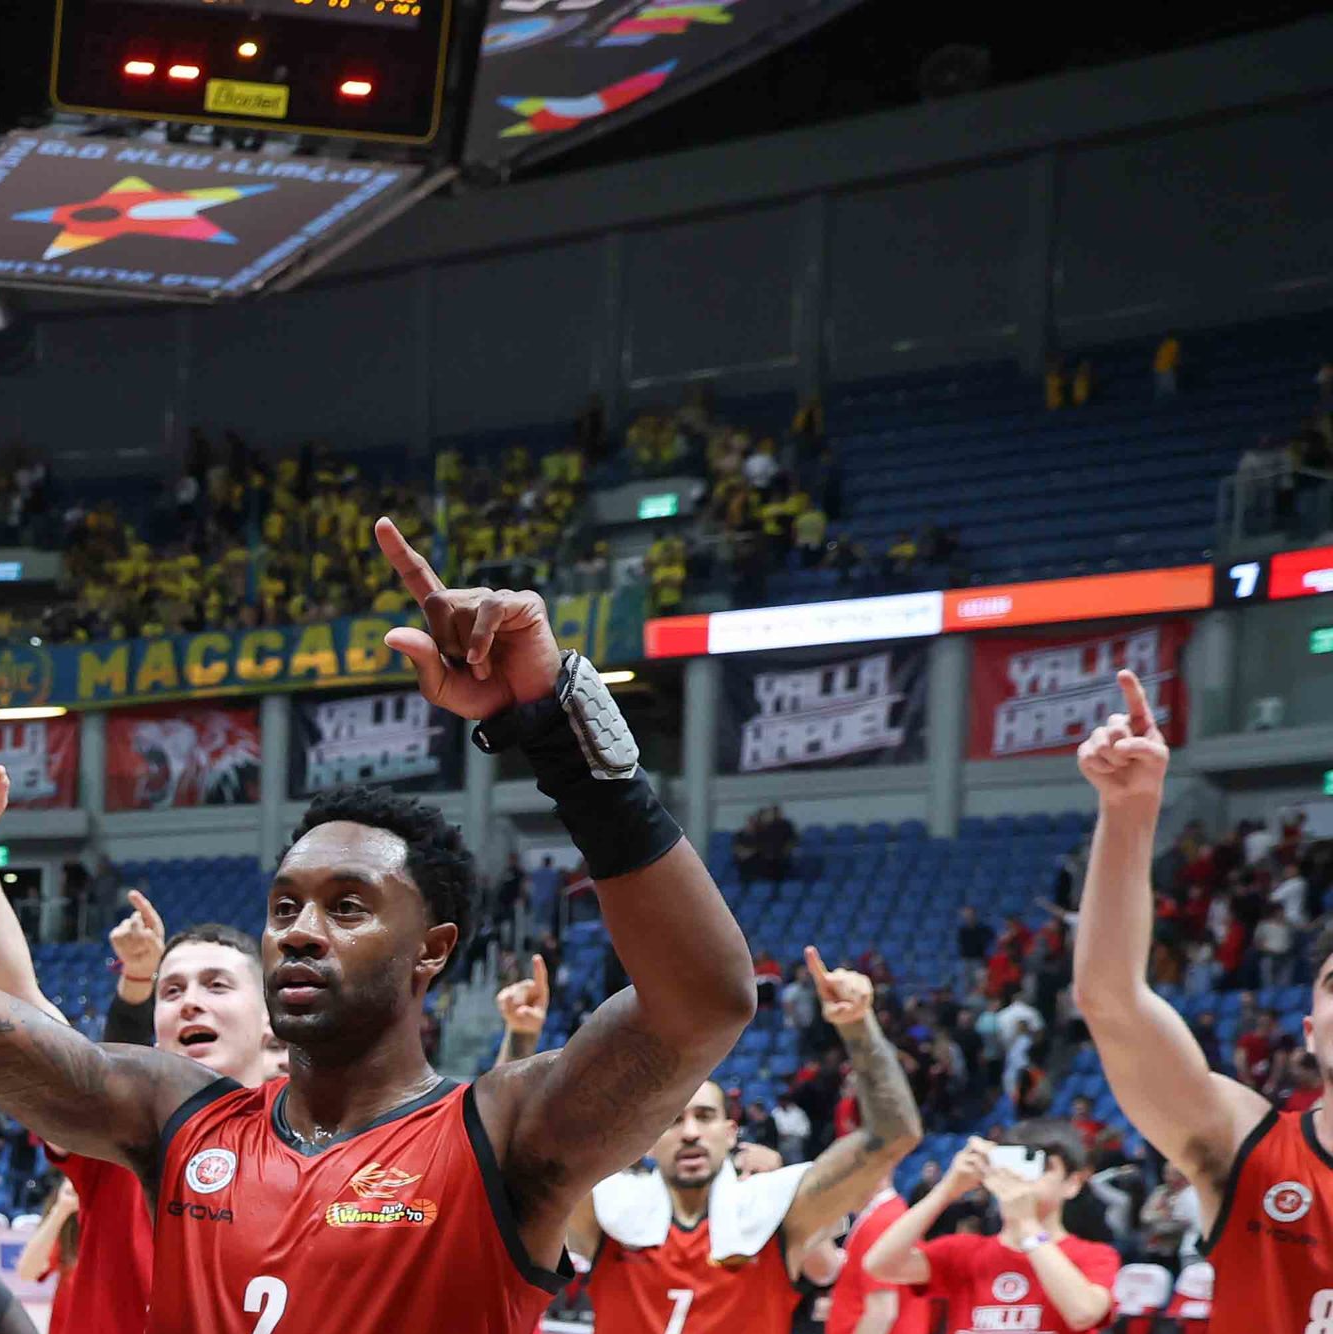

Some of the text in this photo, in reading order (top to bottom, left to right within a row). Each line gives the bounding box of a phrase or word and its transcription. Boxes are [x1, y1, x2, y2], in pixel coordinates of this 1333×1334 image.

[1230, 562, 1261, 598] 7
[76, 616, 413, 700] MACCAB
[753, 653, 893, 718] YALLA
[1009, 628, 1161, 700] YALLA
[317, 694, 431, 745] YALLA
[739, 702, 905, 773] HAPOEL
[991, 685, 1171, 758] HAPO
[340, 1209, 424, 1223] Winner סל
